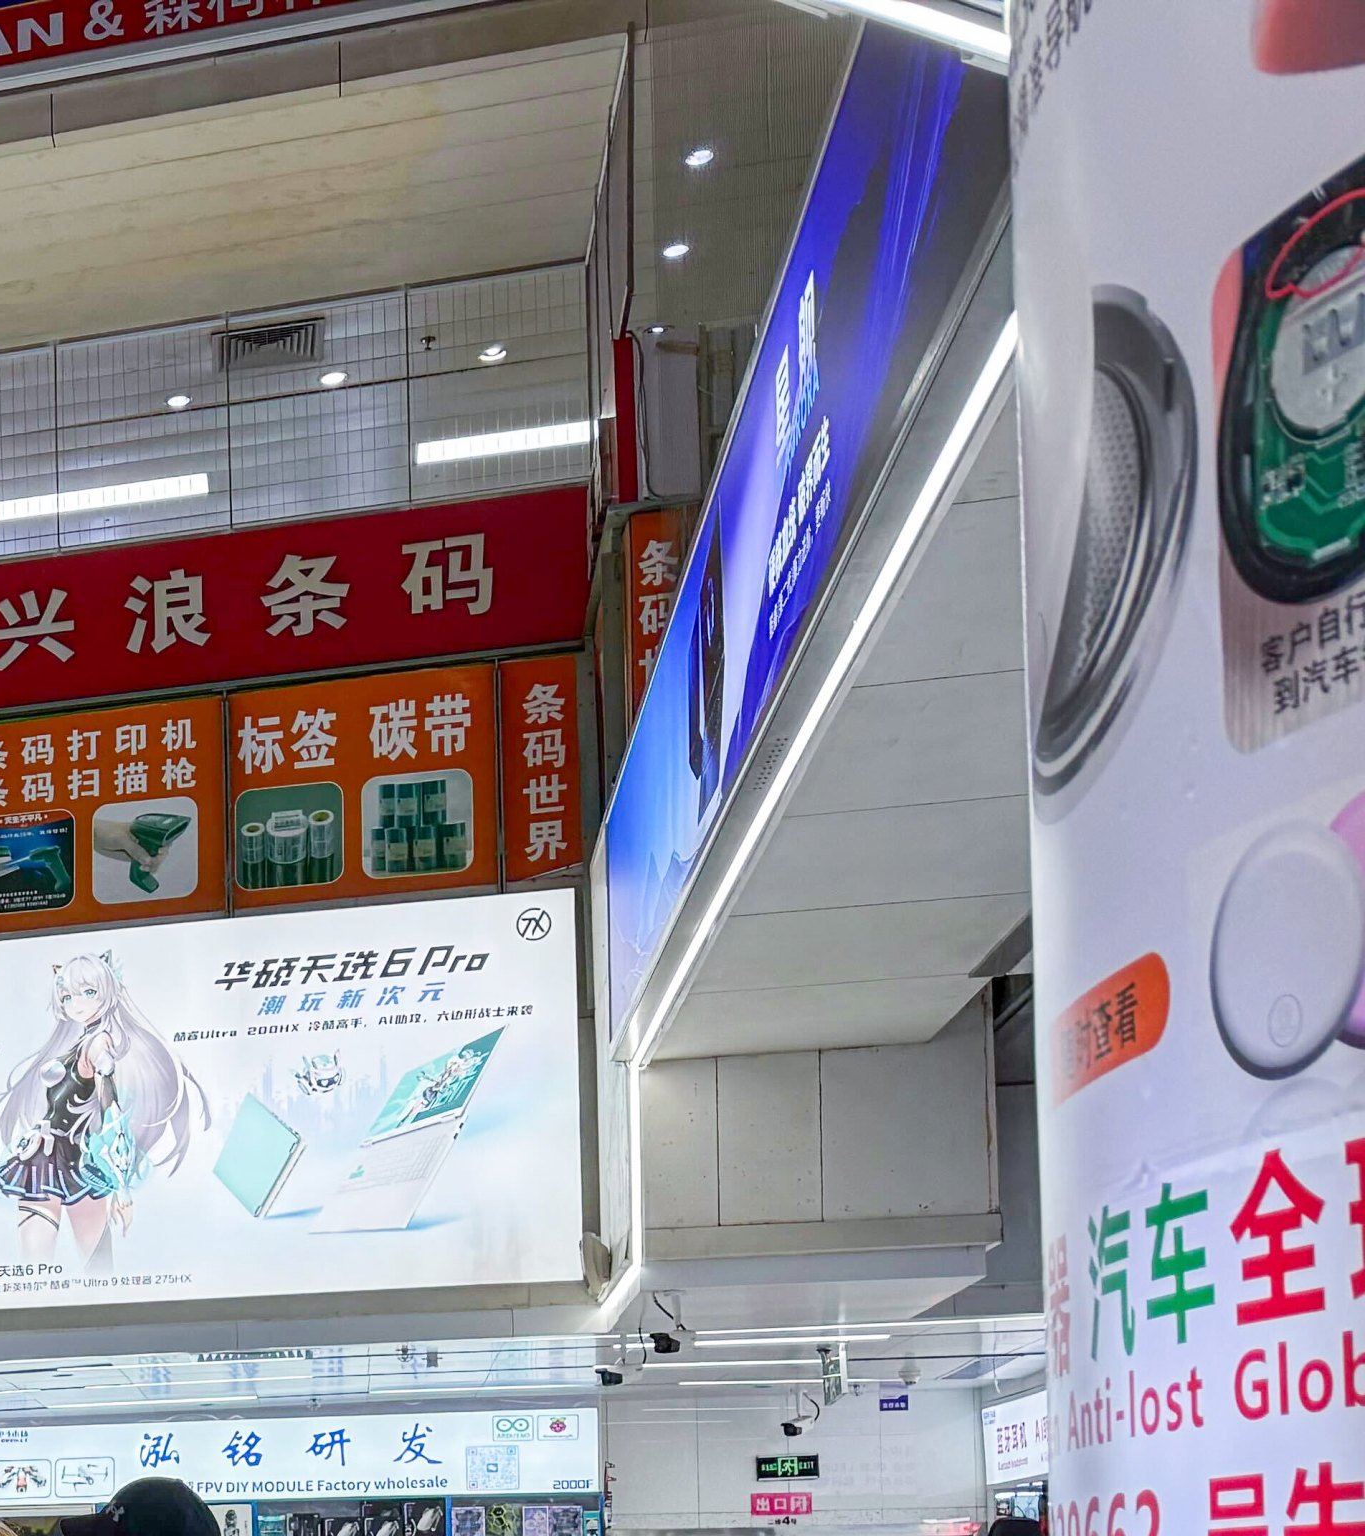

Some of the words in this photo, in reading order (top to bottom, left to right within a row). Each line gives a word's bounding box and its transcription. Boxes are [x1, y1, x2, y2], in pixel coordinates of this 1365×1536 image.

[83, 0, 124, 41] &
[238, 709, 338, 776] 标签
[369, 692, 471, 761] 碳带
[520, 683, 568, 861] 条码世界
[418, 945, 490, 976] Pro
[257, 981, 446, 1016] 潮玩新次元
[38, 1263, 63, 1275] Pro
[1068, 1364, 1207, 1456] Anti-lost
[139, 1424, 442, 1468] 泓铭研发
[197, 1480, 223, 1493] FPV
[226, 1480, 247, 1493] DIY
[249, 1479, 313, 1493] MODULE
[316, 1478, 368, 1493] Factory
[372, 1475, 447, 1489] wholesale
